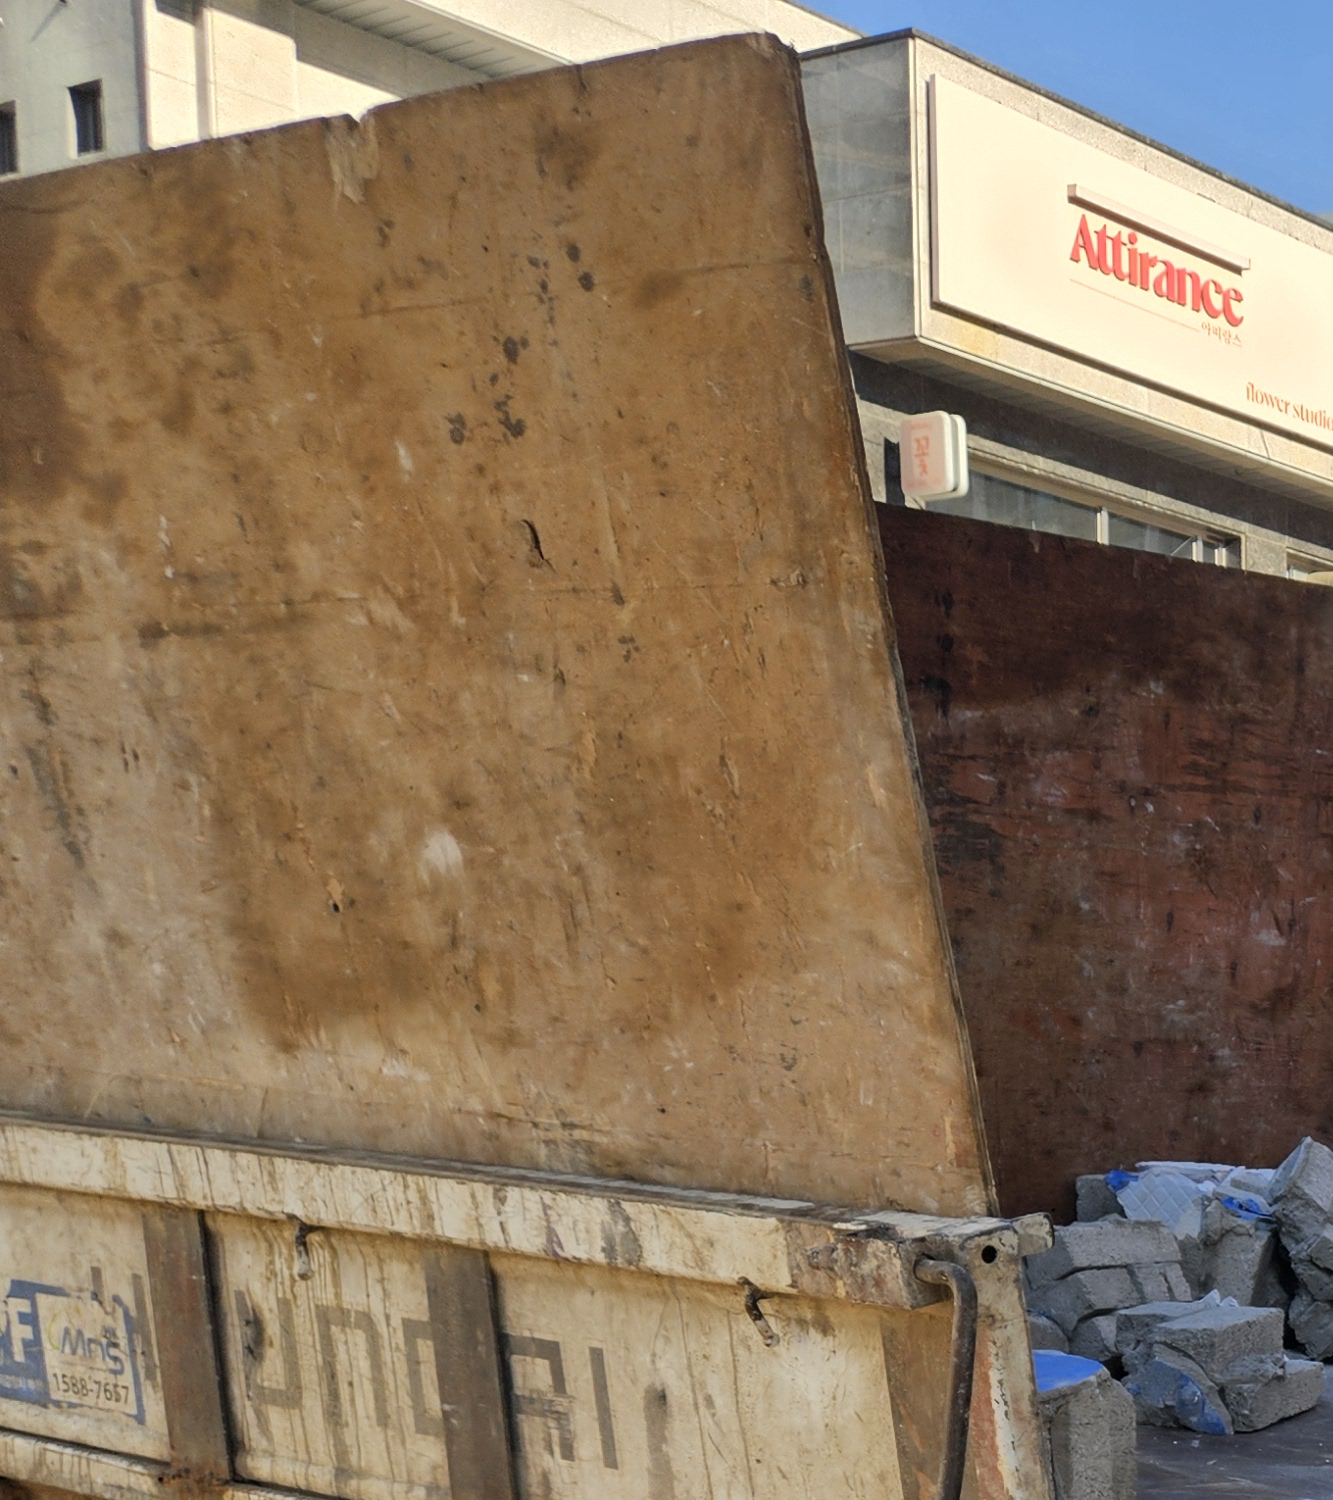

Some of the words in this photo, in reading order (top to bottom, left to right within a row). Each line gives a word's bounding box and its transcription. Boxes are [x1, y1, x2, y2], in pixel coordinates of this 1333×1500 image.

[1070, 214, 1244, 327] Attirance
[1246, 382, 1290, 413] flower
[914, 435, 930, 476] 꽃
